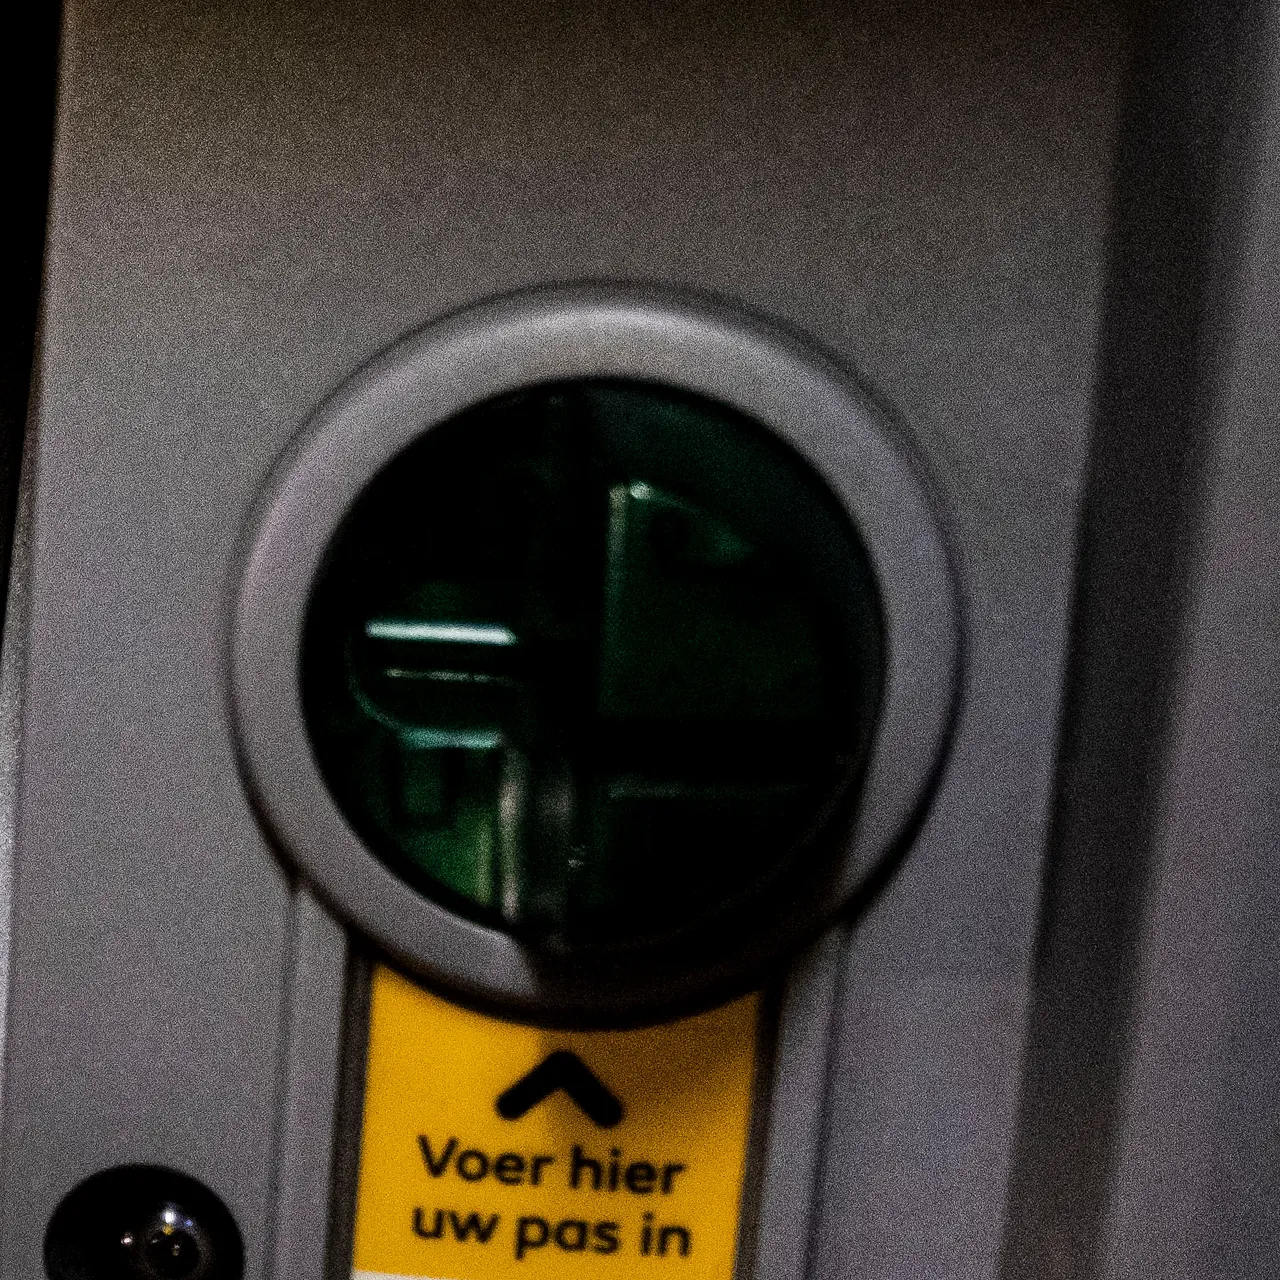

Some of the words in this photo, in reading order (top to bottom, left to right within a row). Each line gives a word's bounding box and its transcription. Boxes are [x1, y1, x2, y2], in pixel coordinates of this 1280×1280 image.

[417, 1133, 554, 1187] Voer
[568, 1144, 686, 1196] hier
[411, 1206, 500, 1244] uw
[514, 1214, 623, 1260] pas
[639, 1213, 693, 1258] in
